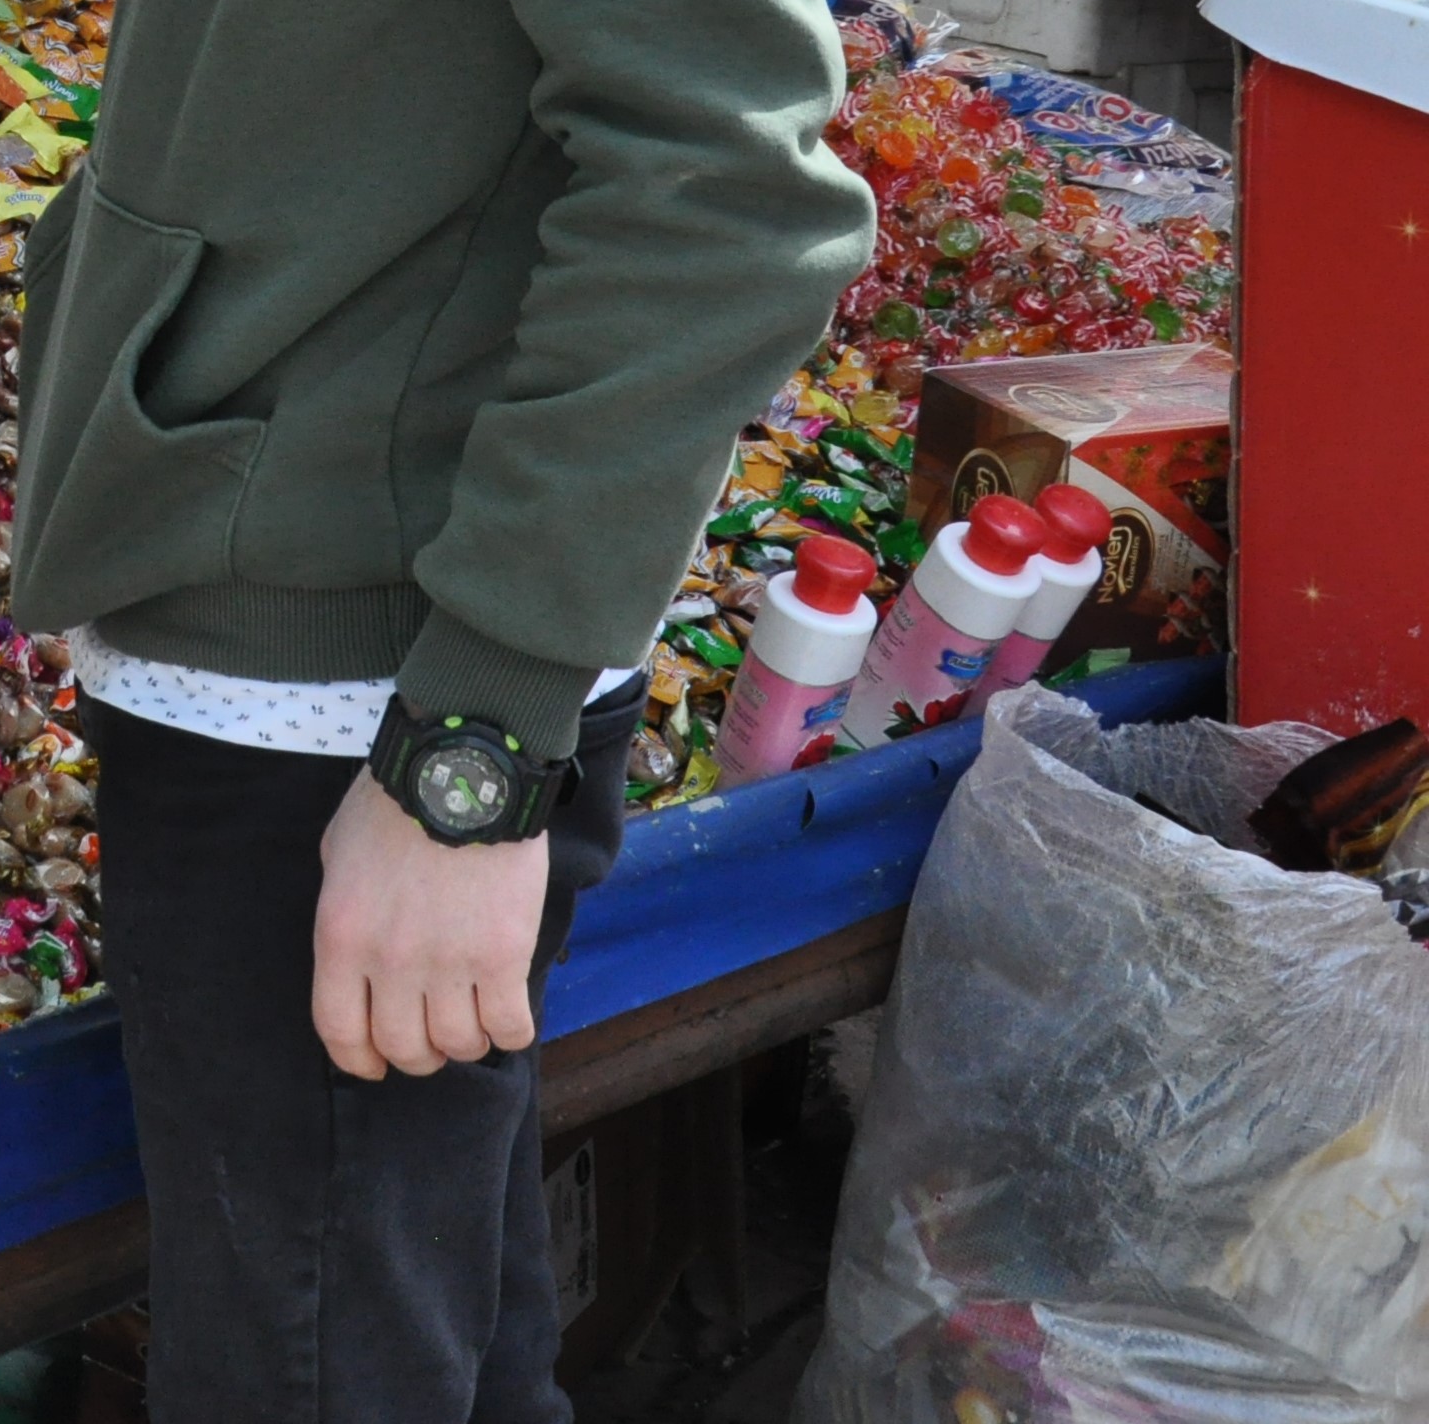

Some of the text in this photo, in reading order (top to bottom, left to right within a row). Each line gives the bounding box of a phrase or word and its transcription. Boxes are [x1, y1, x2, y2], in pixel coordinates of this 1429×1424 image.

[43, 78, 79, 102] Winny
[4, 192, 46, 206] Winny
[1097, 526, 1125, 604] Novien
